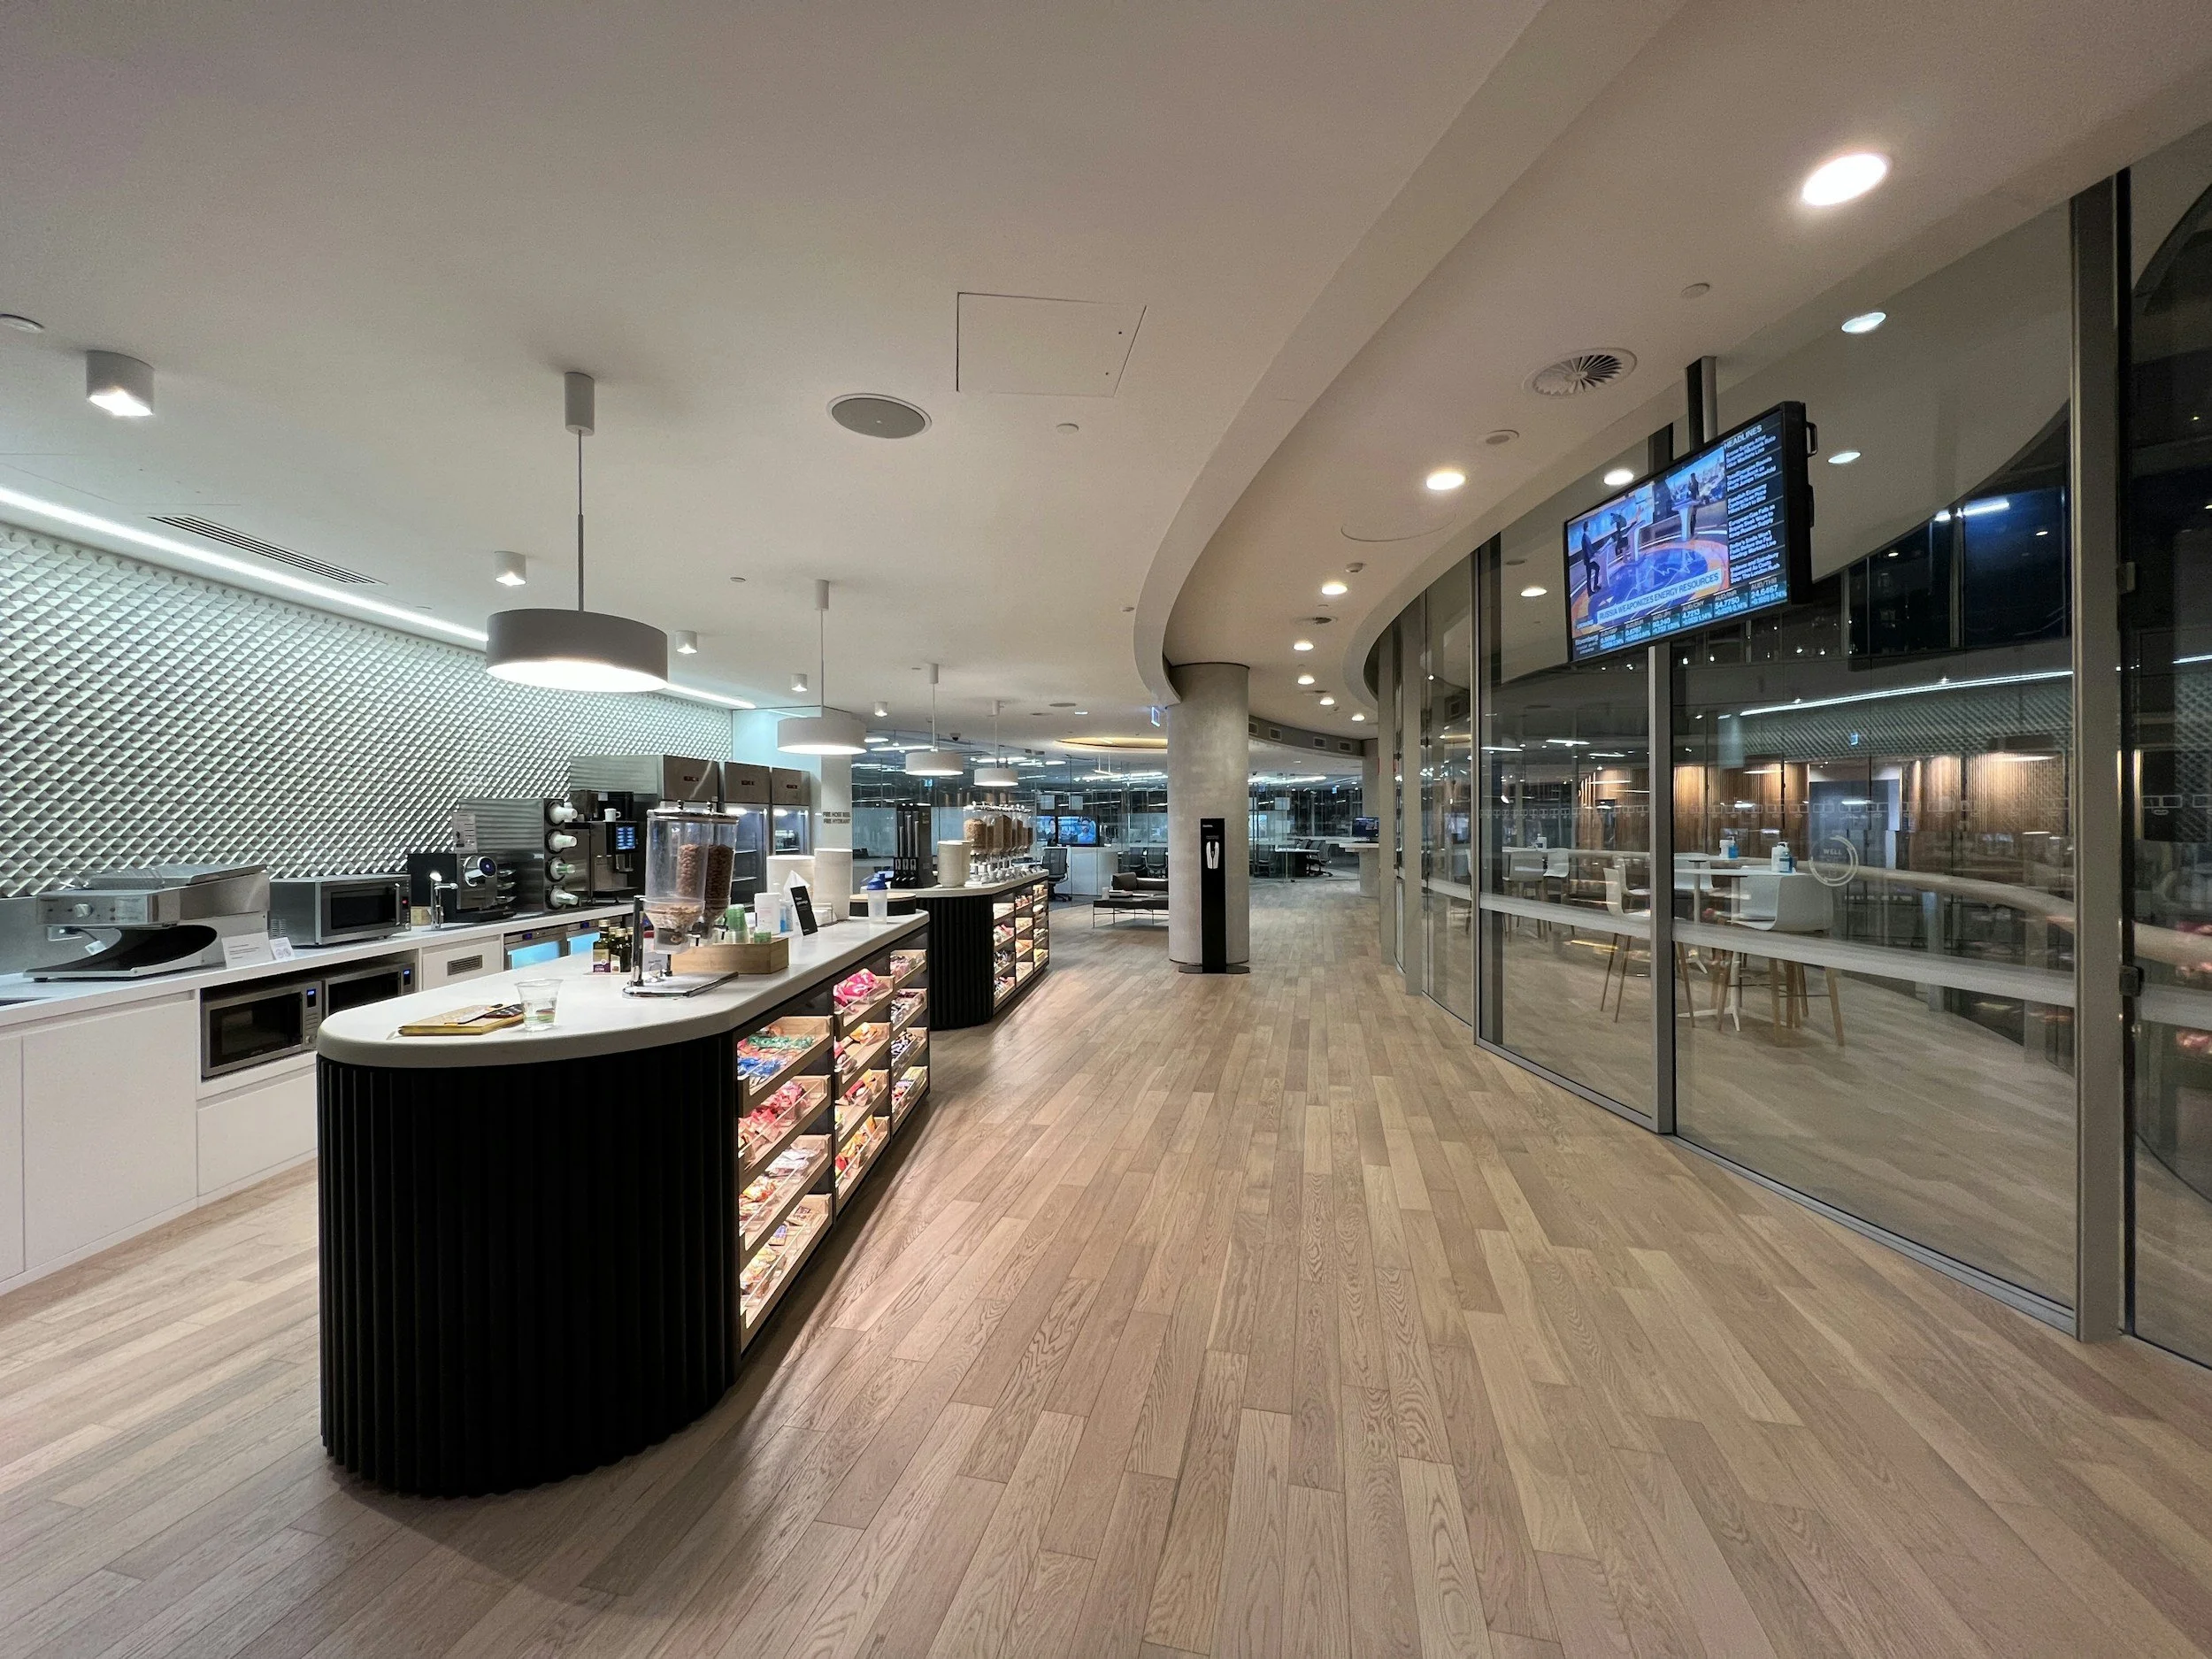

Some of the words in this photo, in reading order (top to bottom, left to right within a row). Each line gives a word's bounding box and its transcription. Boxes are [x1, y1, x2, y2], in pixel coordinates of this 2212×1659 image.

[1724, 425, 1762, 449] HEADLINES
[1600, 607, 1617, 620] RUSSIA
[1618, 595, 1654, 614] WEAPONIZES
[1655, 587, 1678, 603] ENERGY
[1679, 572, 1718, 594] RESOURCES
